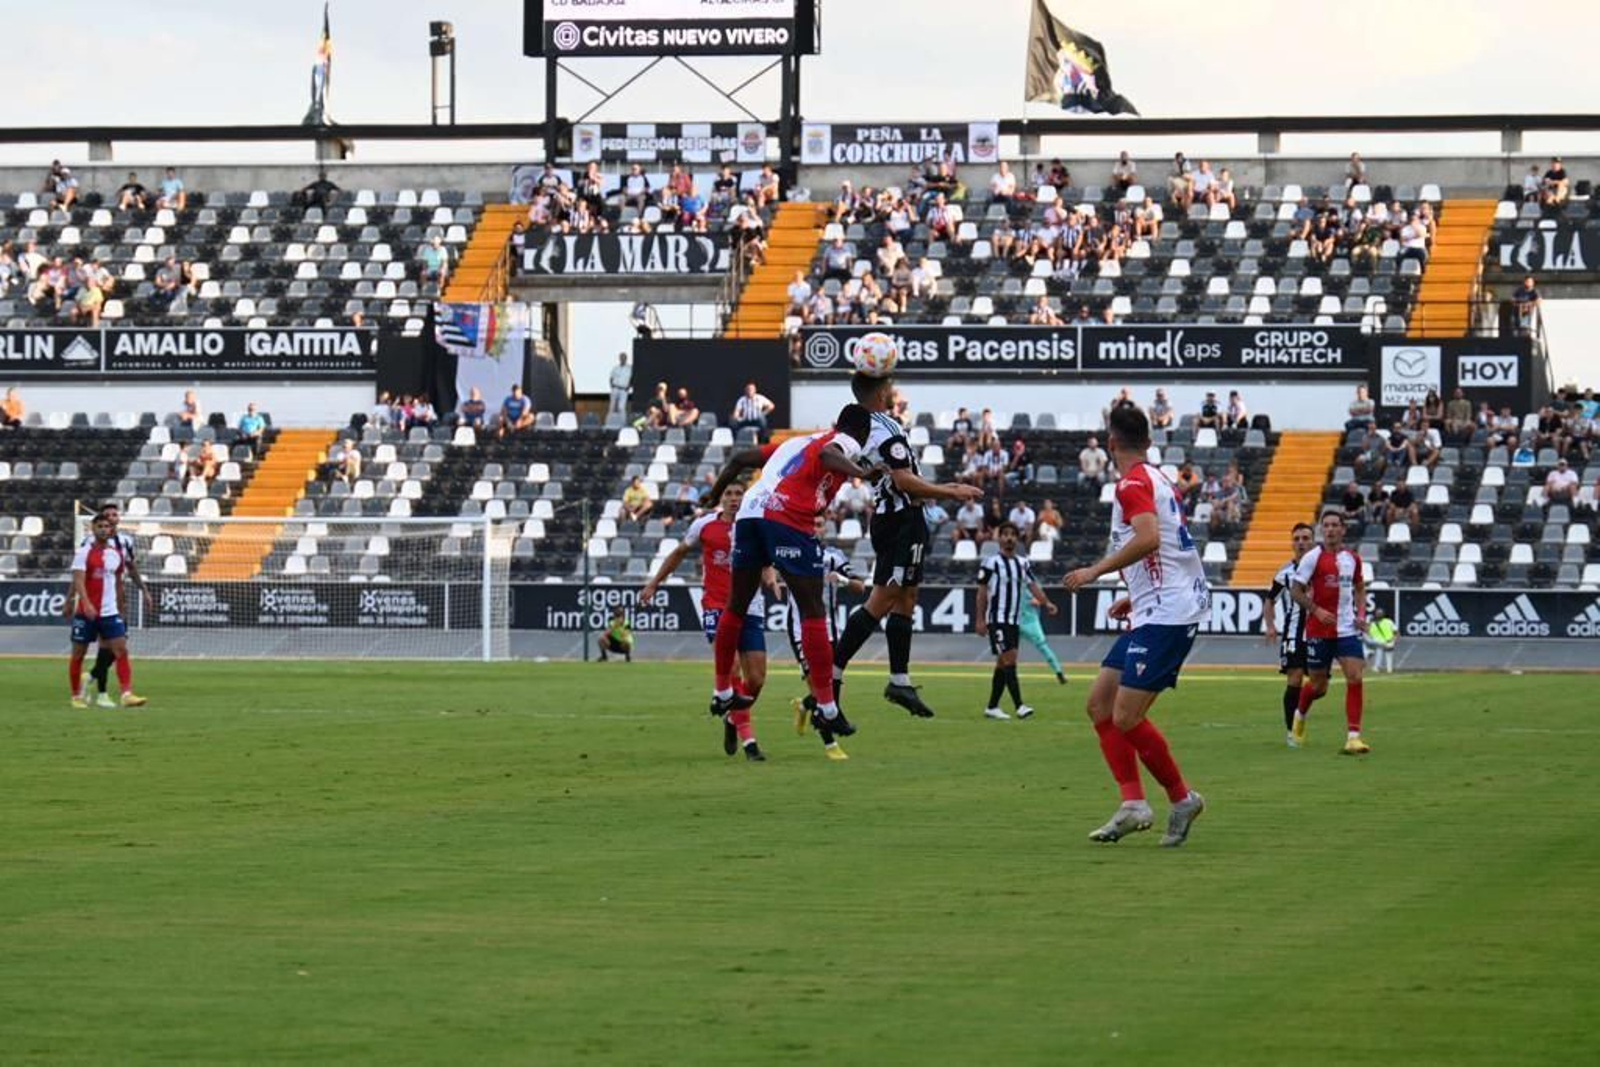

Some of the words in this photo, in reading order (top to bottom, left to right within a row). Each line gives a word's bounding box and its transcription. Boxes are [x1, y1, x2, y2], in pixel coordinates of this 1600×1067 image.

[663, 28, 721, 46] NUEVO
[725, 27, 789, 45] VIVERO
[856, 126, 903, 142] PEÑA
[920, 128, 942, 141] LA
[113, 332, 225, 356] AMALIO
[948, 333, 1075, 361] Pacensis
[1254, 331, 1329, 347] GRUPO
[1240, 347, 1342, 364] PHI4TECH
[1460, 361, 1514, 380] HOY
[931, 588, 969, 632] 4
[1406, 621, 1470, 635] adidas
[1486, 621, 1550, 636] adidas
